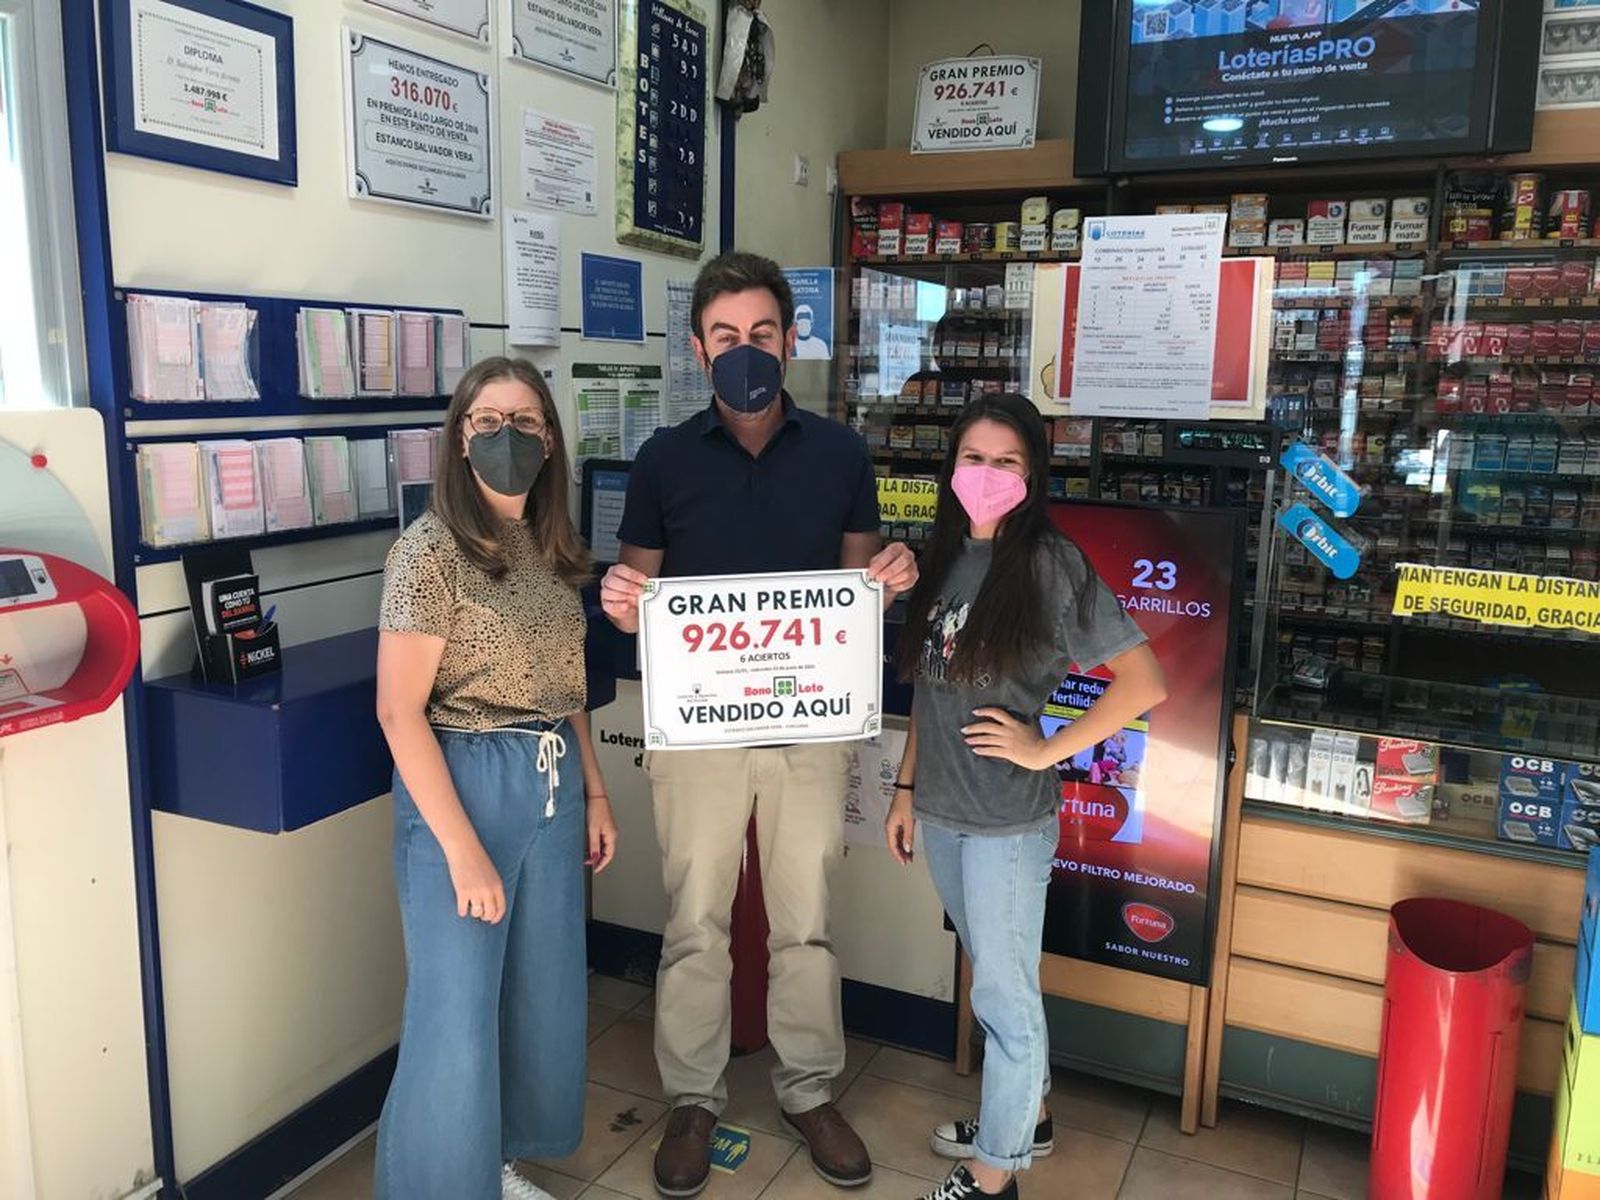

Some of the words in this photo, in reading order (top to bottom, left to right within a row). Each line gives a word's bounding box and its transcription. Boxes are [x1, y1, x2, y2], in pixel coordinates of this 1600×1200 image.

[1270, 34, 1300, 43] NUEVA
[1303, 31, 1322, 41] APP
[183, 44, 224, 64] DIPLOMA
[1218, 36, 1376, 71] LoteríasPRO
[388, 59, 415, 76] HEMOS
[416, 68, 459, 88] ENTREGADO
[929, 67, 968, 82] GRAN
[972, 64, 1026, 79] PREMIO
[1221, 70, 1271, 83] Conéctate
[1272, 71, 1279, 79] a
[1281, 68, 1292, 78] tu
[1293, 66, 1322, 77] punto
[1324, 62, 1337, 74] de
[1339, 60, 1369, 72] venta
[390, 76, 451, 111] 316.070
[452, 102, 459, 114] €
[933, 80, 1006, 101] 926.741
[1010, 87, 1019, 96] €
[366, 97, 379, 109] EN
[379, 100, 413, 118] PREMIOS
[420, 112, 430, 122] LO
[430, 114, 454, 129] LARGO
[380, 113, 392, 124] EN
[393, 116, 410, 129] ESTE
[410, 120, 435, 135] PUNTO
[446, 129, 468, 142] VENTA
[927, 126, 982, 140] VENDIDO
[985, 121, 1017, 137] AQUÍ
[375, 132, 413, 150] ESTANCO
[414, 142, 454, 158] SALVADOR
[454, 150, 474, 163] VERA
[1350, 222, 1381, 232] Fumar
[1393, 221, 1425, 231] Fumar
[1352, 232, 1377, 242] mata
[1395, 231, 1421, 241] mata
[884, 481, 897, 493] LA
[901, 481, 935, 495] DISTA
[903, 504, 936, 519] GRAC
[1131, 558, 1178, 591] 23
[1399, 566, 1501, 590] MANTENGAN
[1507, 575, 1529, 593] LA
[1535, 578, 1600, 599] DISTAN
[224, 597, 243, 610] COMO
[232, 587, 256, 601] CUENTA
[667, 590, 746, 616] GRAN
[756, 586, 856, 612] PREMIO
[1403, 595, 1424, 611] DE
[1430, 597, 1532, 625] SEGURIDAD,
[681, 617, 822, 653] 926.741
[835, 630, 848, 645] €
[248, 646, 275, 662] NICKEL
[739, 654, 747, 664] 6
[748, 651, 791, 663] ACIERTOS
[744, 686, 772, 697] Bono
[798, 683, 824, 694] Loto
[678, 700, 784, 724] VENDIDO
[793, 692, 851, 718] AQUÍ
[1511, 757, 1554, 773] OCB
[1461, 793, 1494, 806] OCB
[1509, 802, 1552, 819] OCB
[1081, 862, 1122, 881] FILTRO
[1124, 870, 1196, 894] MEJORADO
[1130, 913, 1168, 930] Fortuna
[1105, 940, 1139, 957] SABOR
[1141, 948, 1191, 968] NUESTRO
